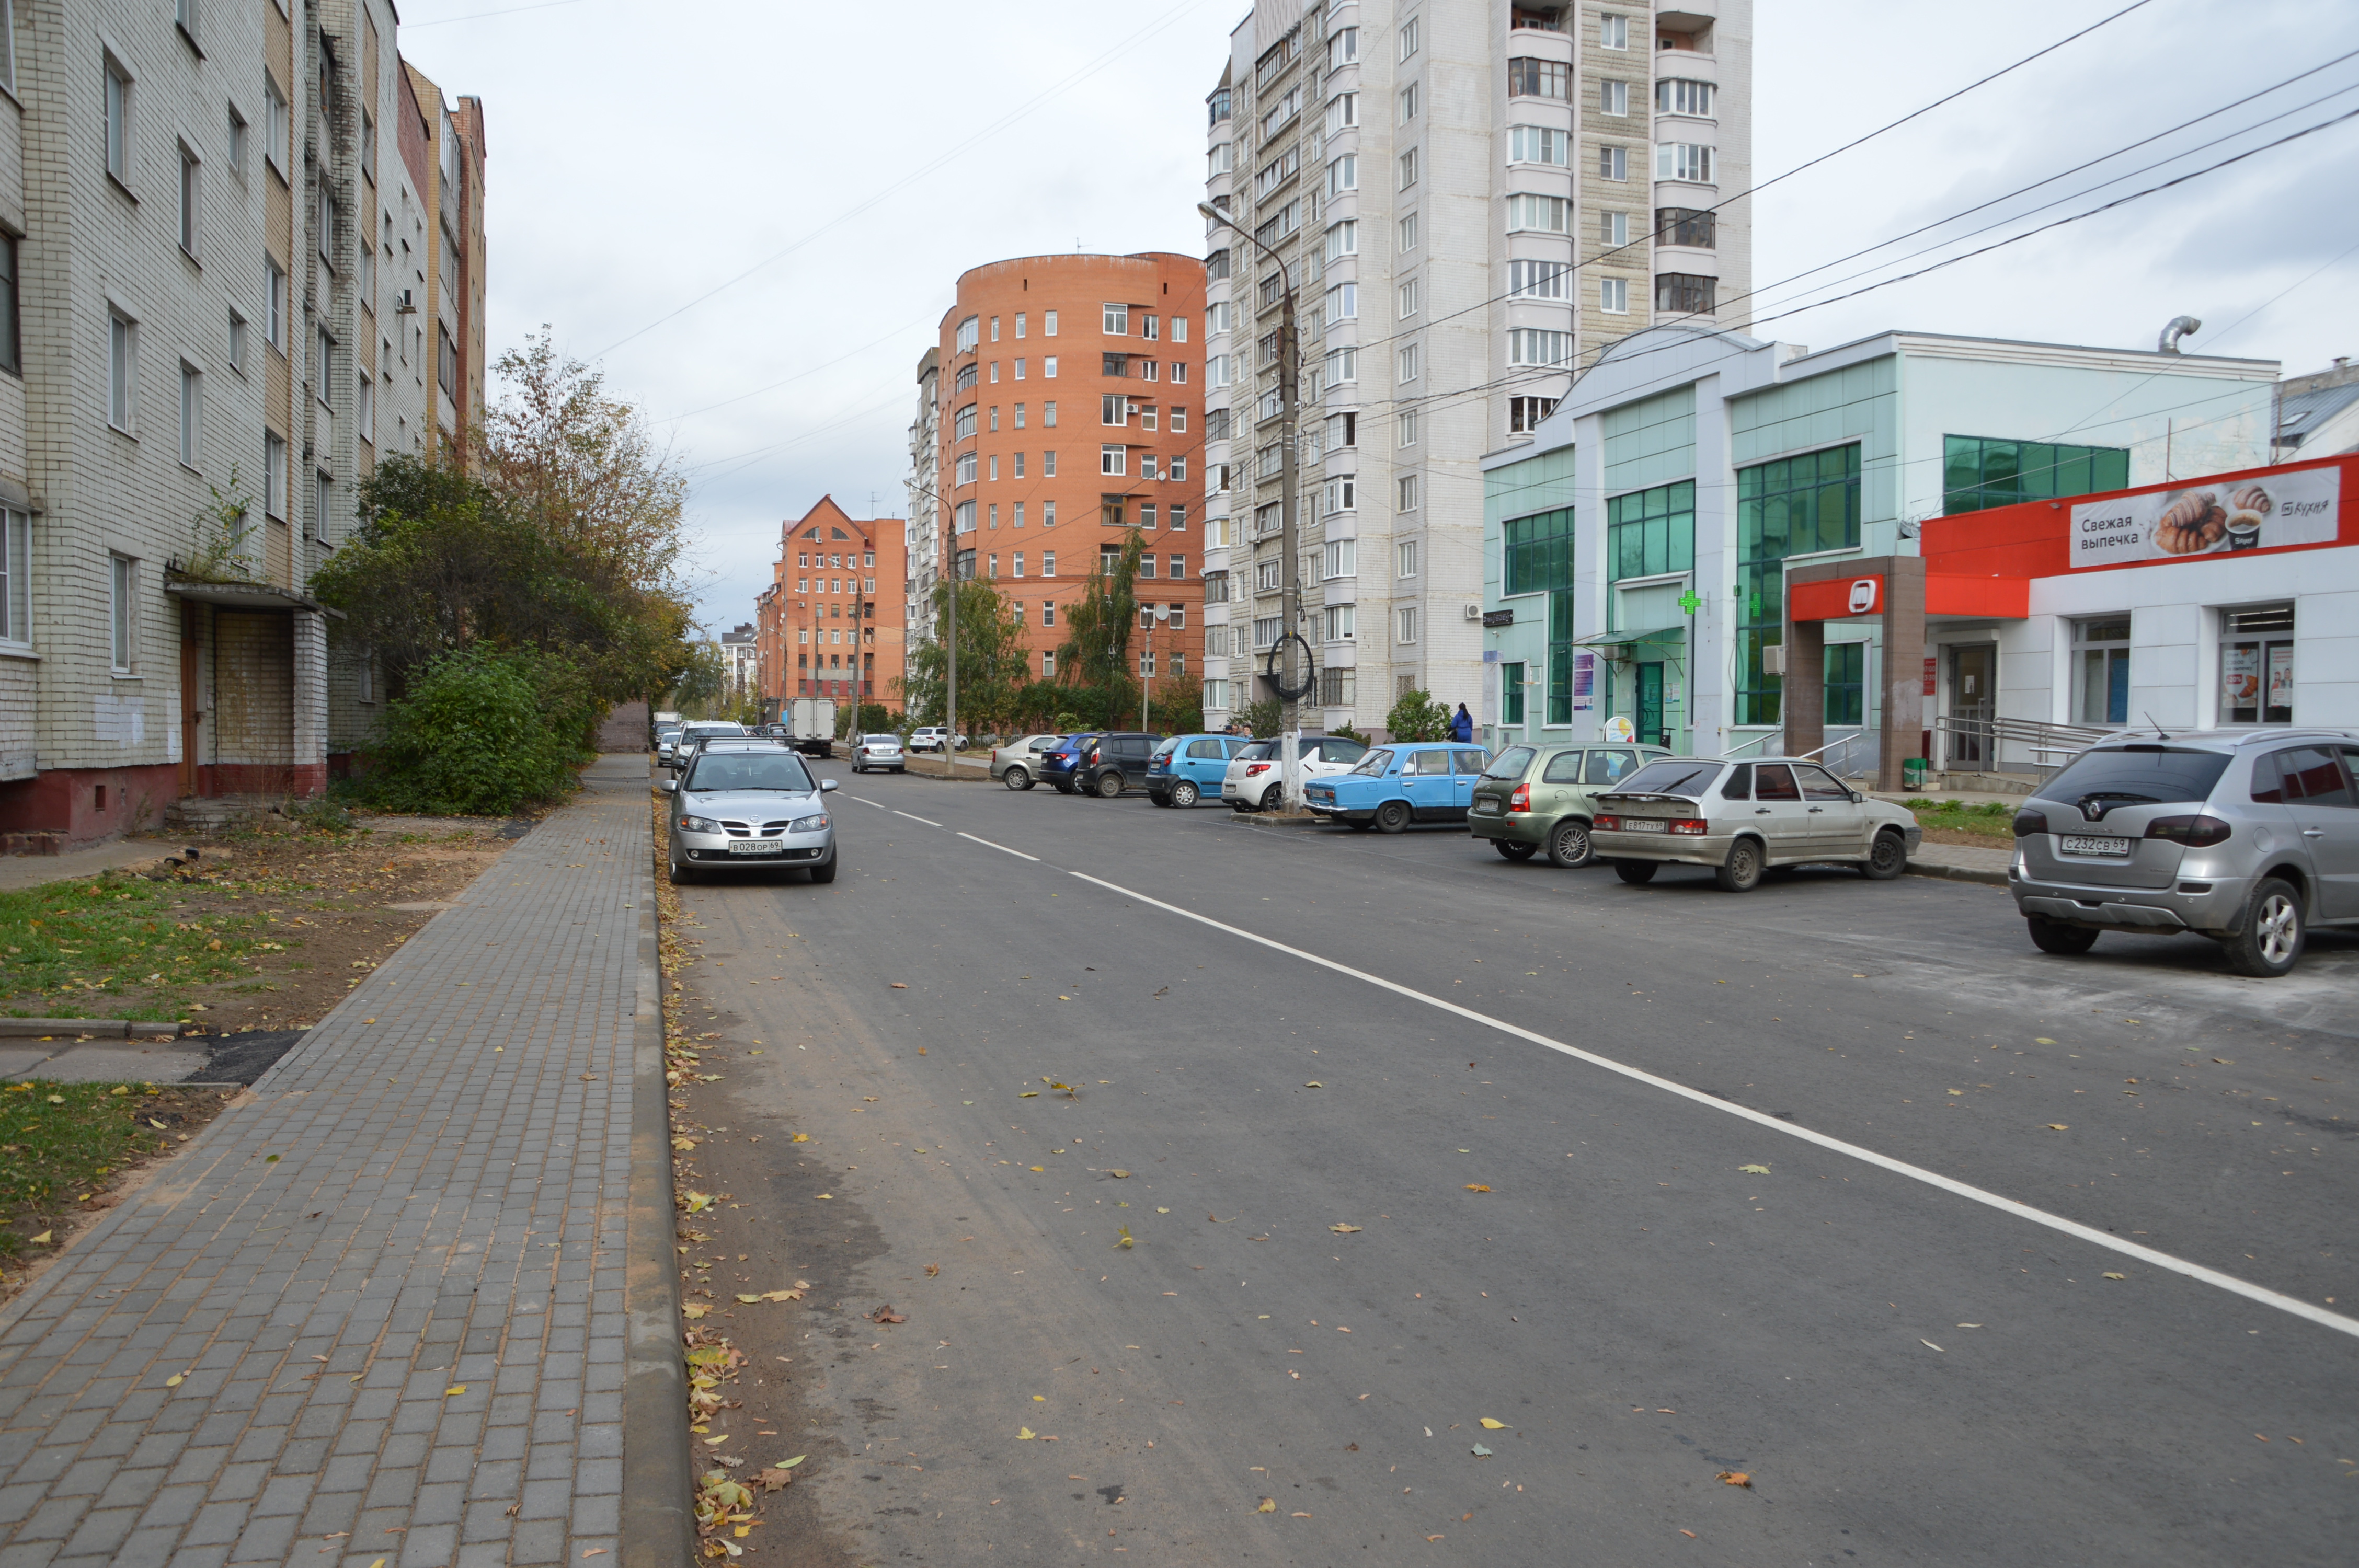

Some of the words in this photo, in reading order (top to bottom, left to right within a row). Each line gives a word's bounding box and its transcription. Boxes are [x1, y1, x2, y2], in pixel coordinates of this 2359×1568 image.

[2294, 500, 2329, 517] КУХНЯ
[2082, 516, 2132, 532] Свежая
[2081, 533, 2138, 549] выпечка
[733, 843, 768, 851] В028ОР
[2066, 838, 2110, 850] С232СВ
[2113, 839, 2125, 848] 69
